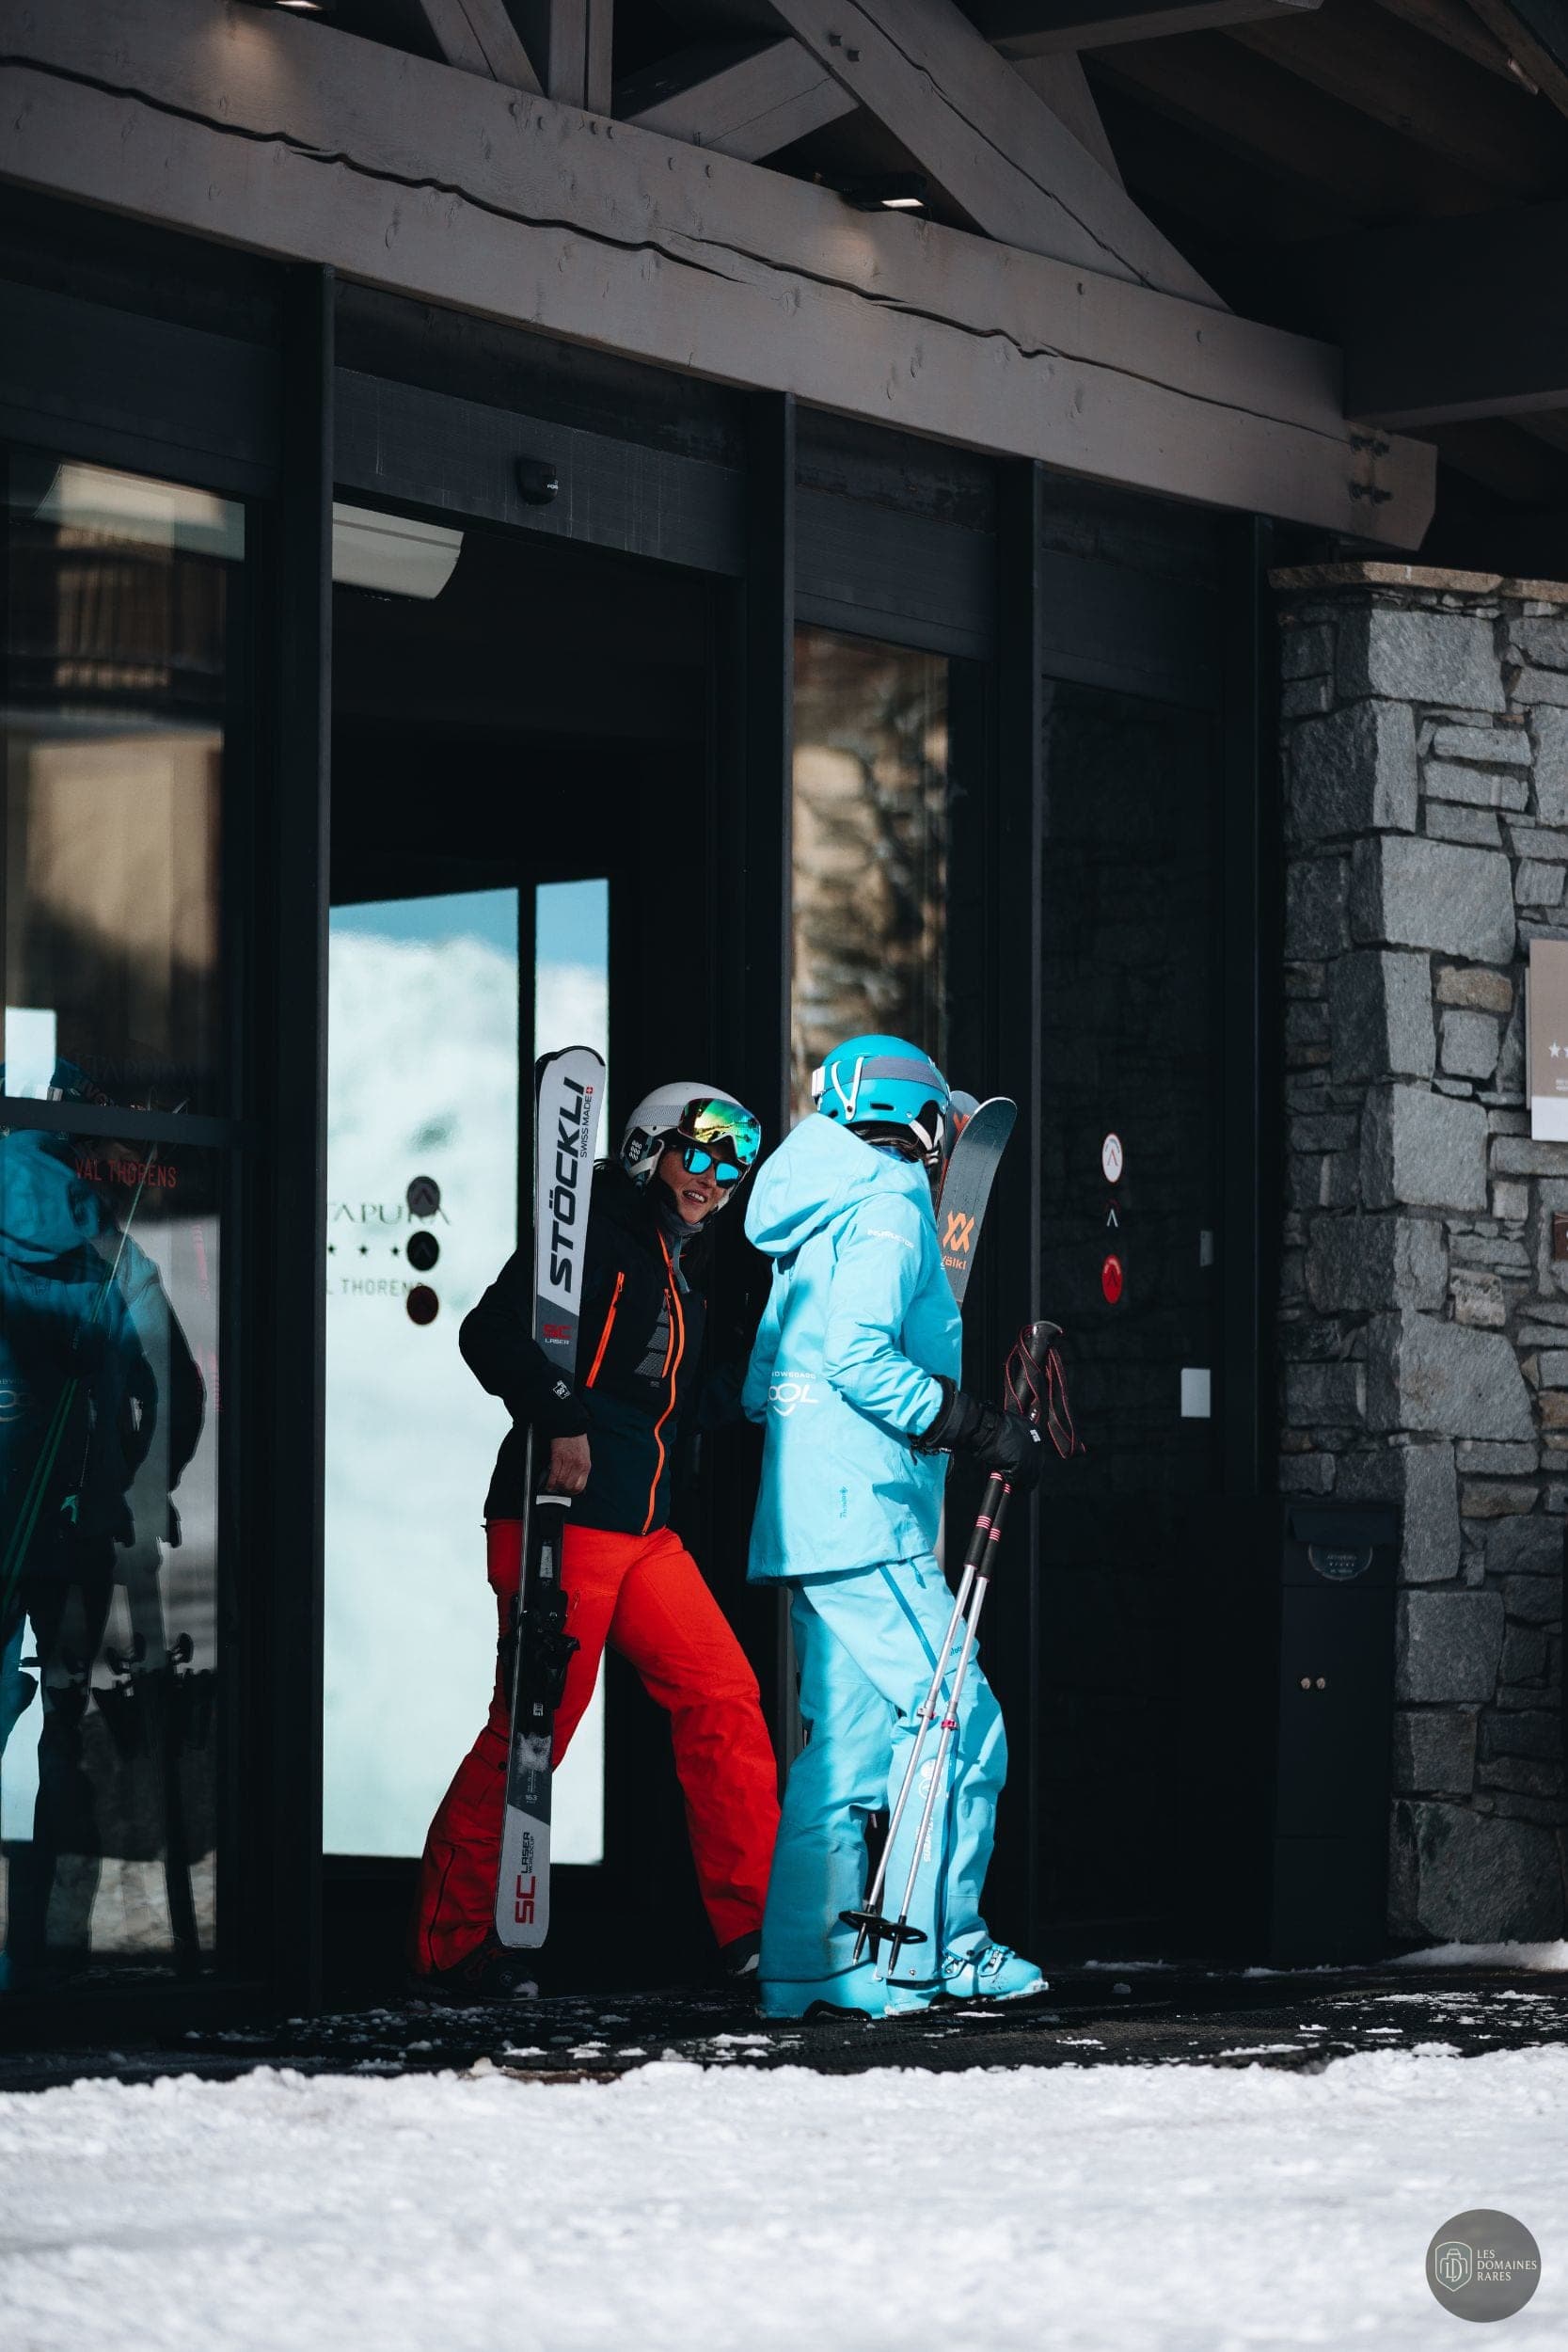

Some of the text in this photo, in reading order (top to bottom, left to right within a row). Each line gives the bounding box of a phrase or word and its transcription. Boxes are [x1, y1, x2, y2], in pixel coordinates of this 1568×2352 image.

[580, 1095, 593, 1158] SWISS MADE
[75, 1158, 177, 1187] VAL THORENS
[549, 1076, 585, 1294] STÖCKLI
[543, 1324, 572, 1340] SC
[520, 1832, 531, 1874] LASER
[515, 1875, 536, 1925] SC
